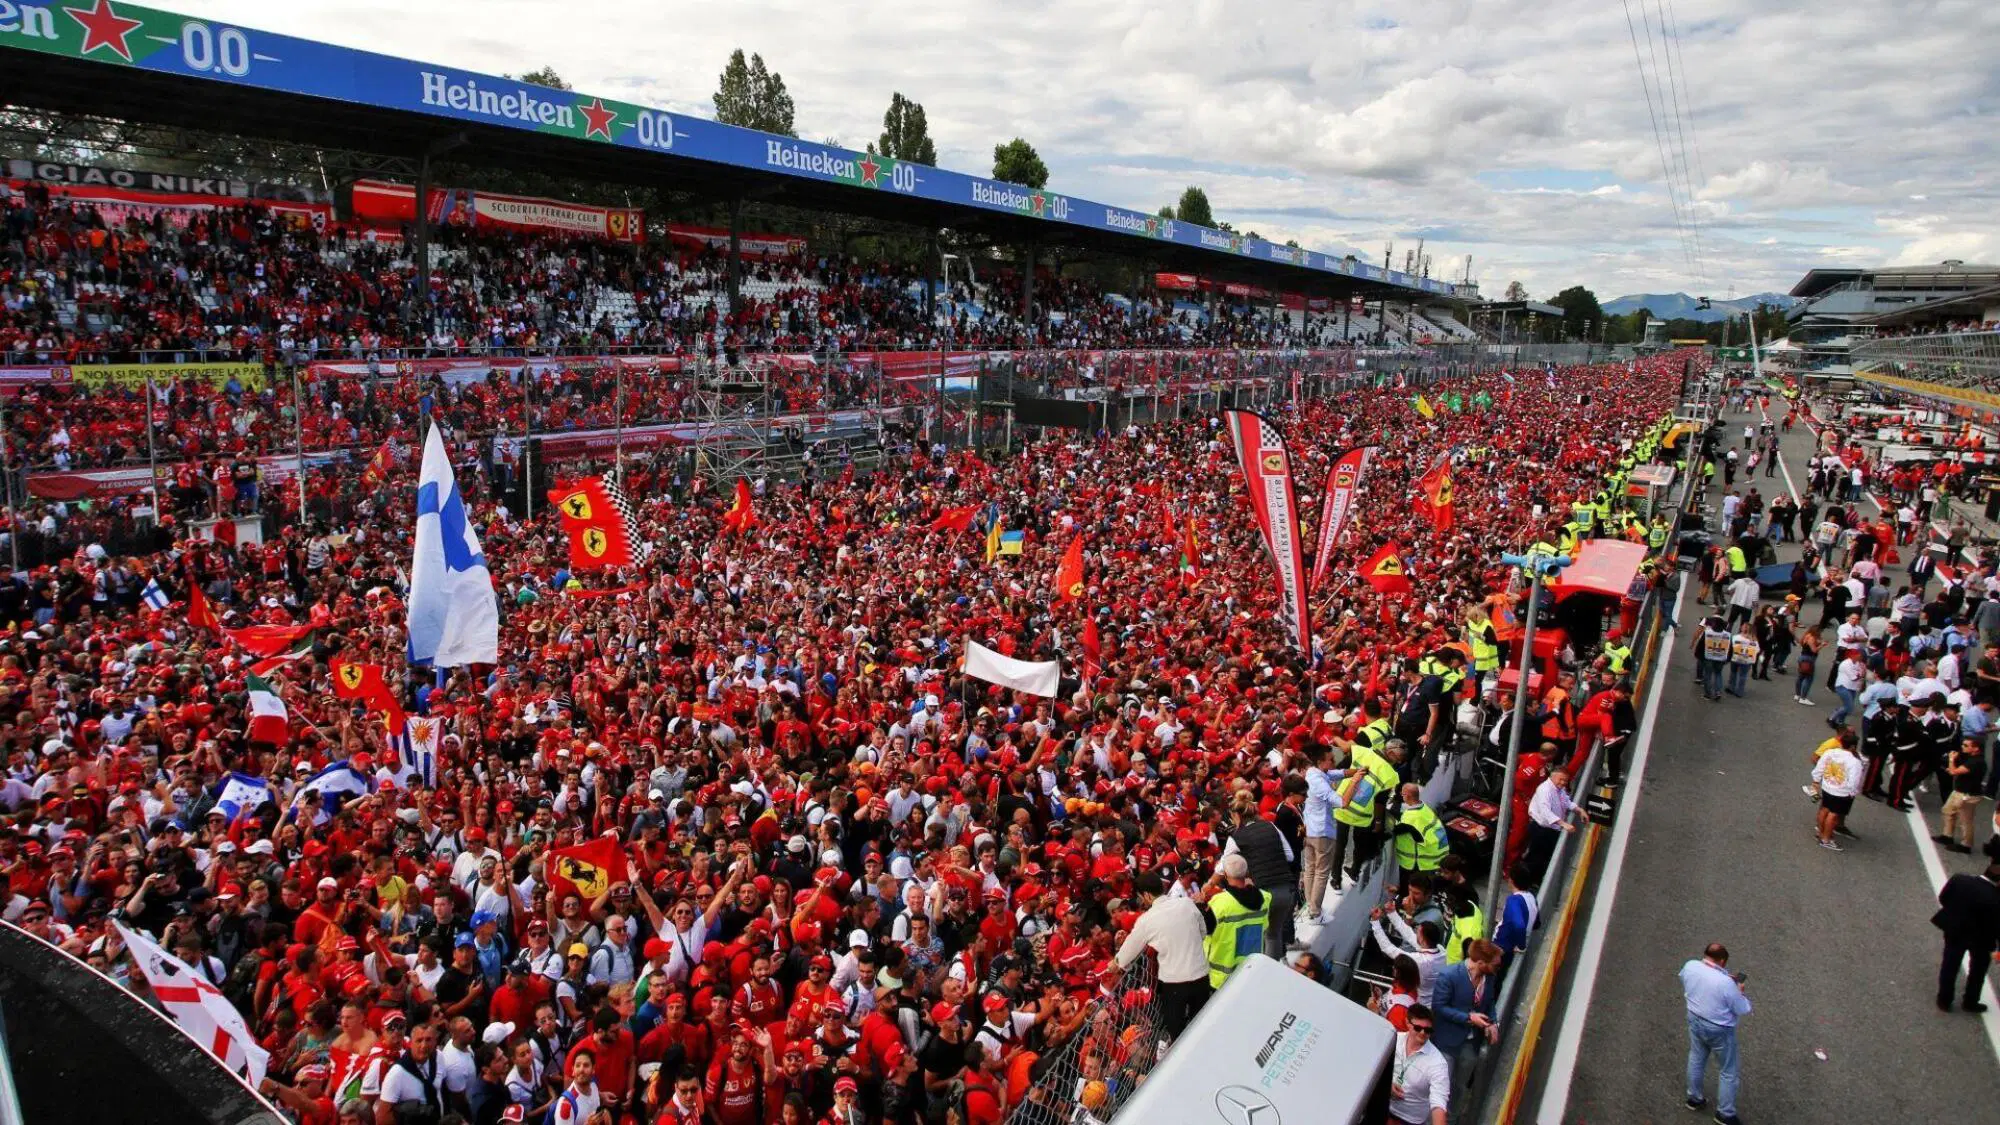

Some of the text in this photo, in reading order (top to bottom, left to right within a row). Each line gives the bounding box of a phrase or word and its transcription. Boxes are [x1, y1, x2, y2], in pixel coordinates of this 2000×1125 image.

[180, 20, 250, 76] 0.0
[421, 71, 673, 150] Heineken 0.0
[38, 163, 228, 197] CIAO NIKI
[766, 139, 915, 193] Heineken 0.0
[971, 181, 1030, 211] Heineken
[491, 202, 598, 223] SCUDERIA FERRARI CLUB
[1106, 209, 1146, 233] Heineken
[1201, 229, 1230, 249] Heineken
[116, 369, 126, 380] SI
[159, 367, 224, 378] DESCRIVERE
[227, 366, 240, 377] LA
[97, 479, 152, 490] ALESSANDRIA
[1260, 1019, 1313, 1089] PETRONAS
